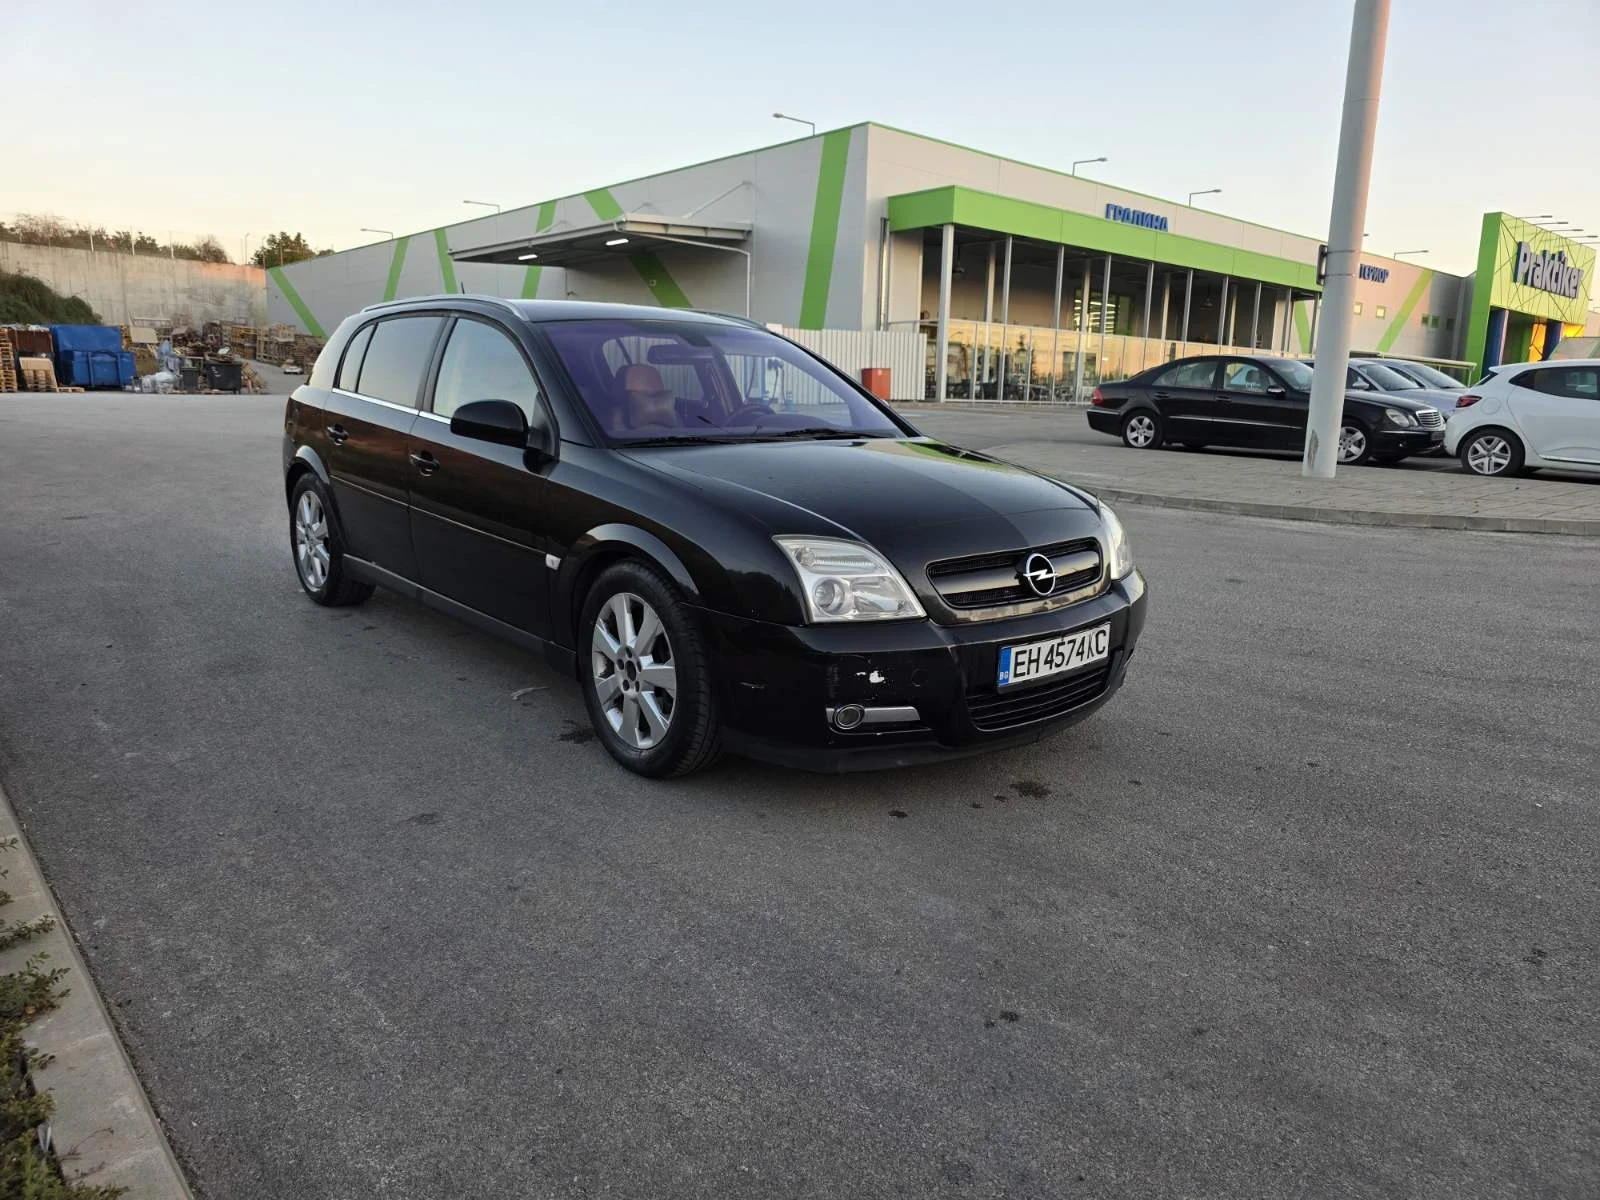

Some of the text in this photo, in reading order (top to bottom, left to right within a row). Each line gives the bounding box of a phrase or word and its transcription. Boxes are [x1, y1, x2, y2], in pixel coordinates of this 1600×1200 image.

[1359, 263, 1389, 283] ТЕРИОР
[1513, 241, 1584, 299] Praktiker
[1013, 647, 1041, 678] EH
[1043, 635, 1086, 670] 4574
[999, 671, 1009, 680] BG
